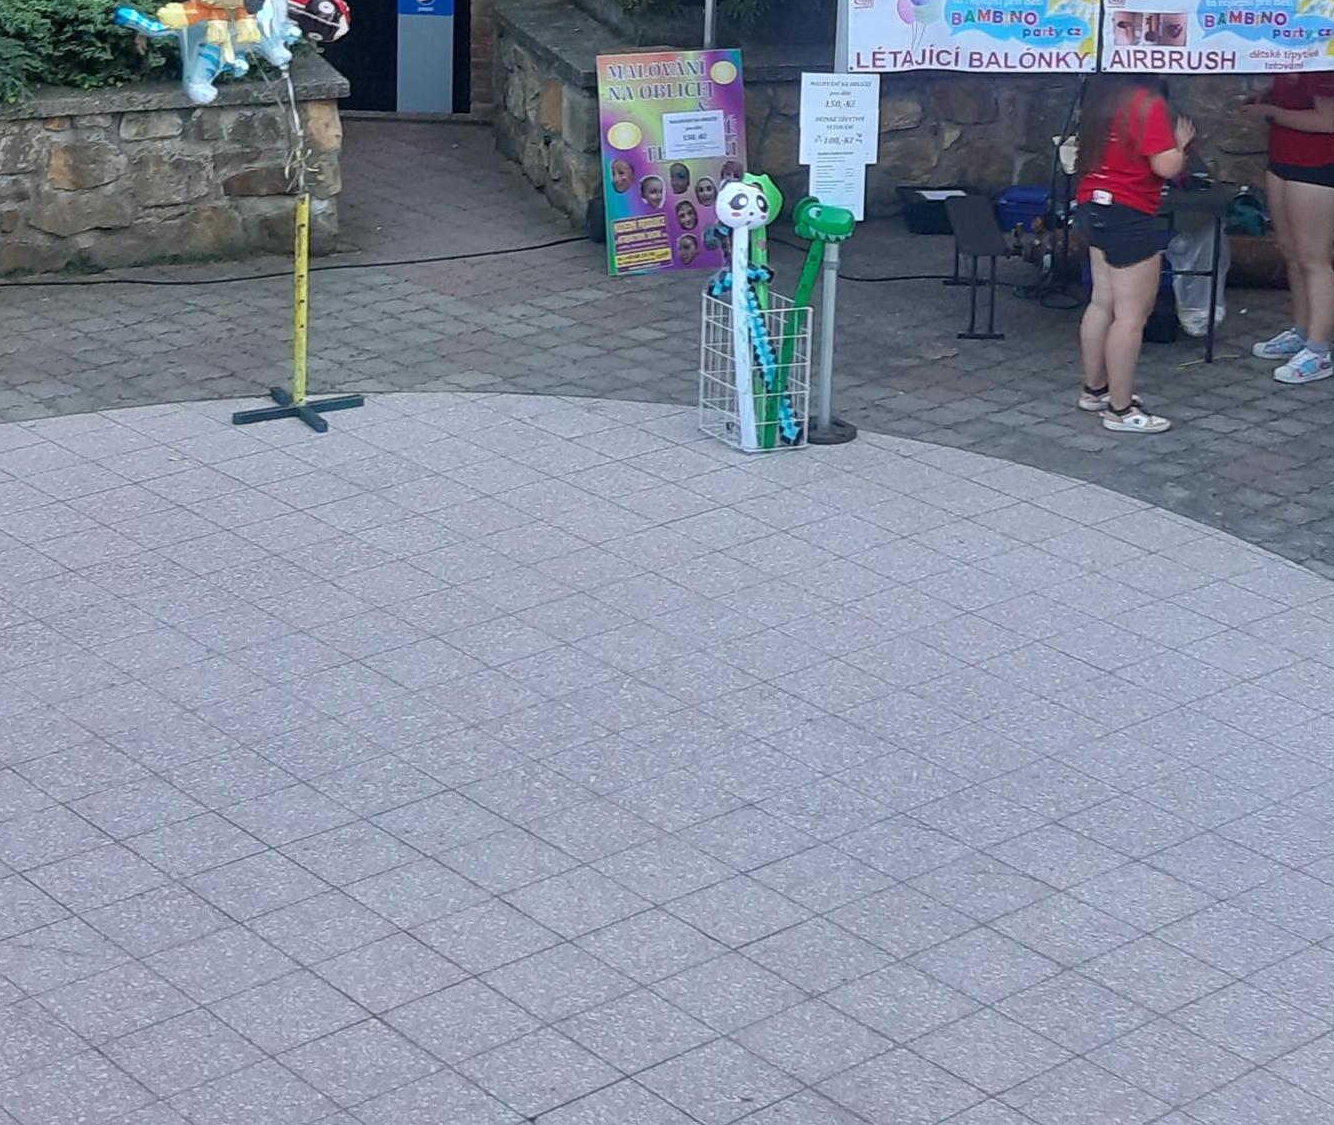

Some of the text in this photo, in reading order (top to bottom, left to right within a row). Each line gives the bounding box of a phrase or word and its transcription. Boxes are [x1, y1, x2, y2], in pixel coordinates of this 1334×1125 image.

[951, 8, 1038, 26] BAMBINO
[1204, 11, 1288, 28] BAMBINO
[1022, 27, 1083, 39] party.cz
[1273, 27, 1333, 40] party.cz
[855, 44, 1091, 70] LÉTAJÍCÍ BALÓNKY
[1110, 50, 1237, 70] AIRBRUSH
[608, 85, 635, 102] NA
